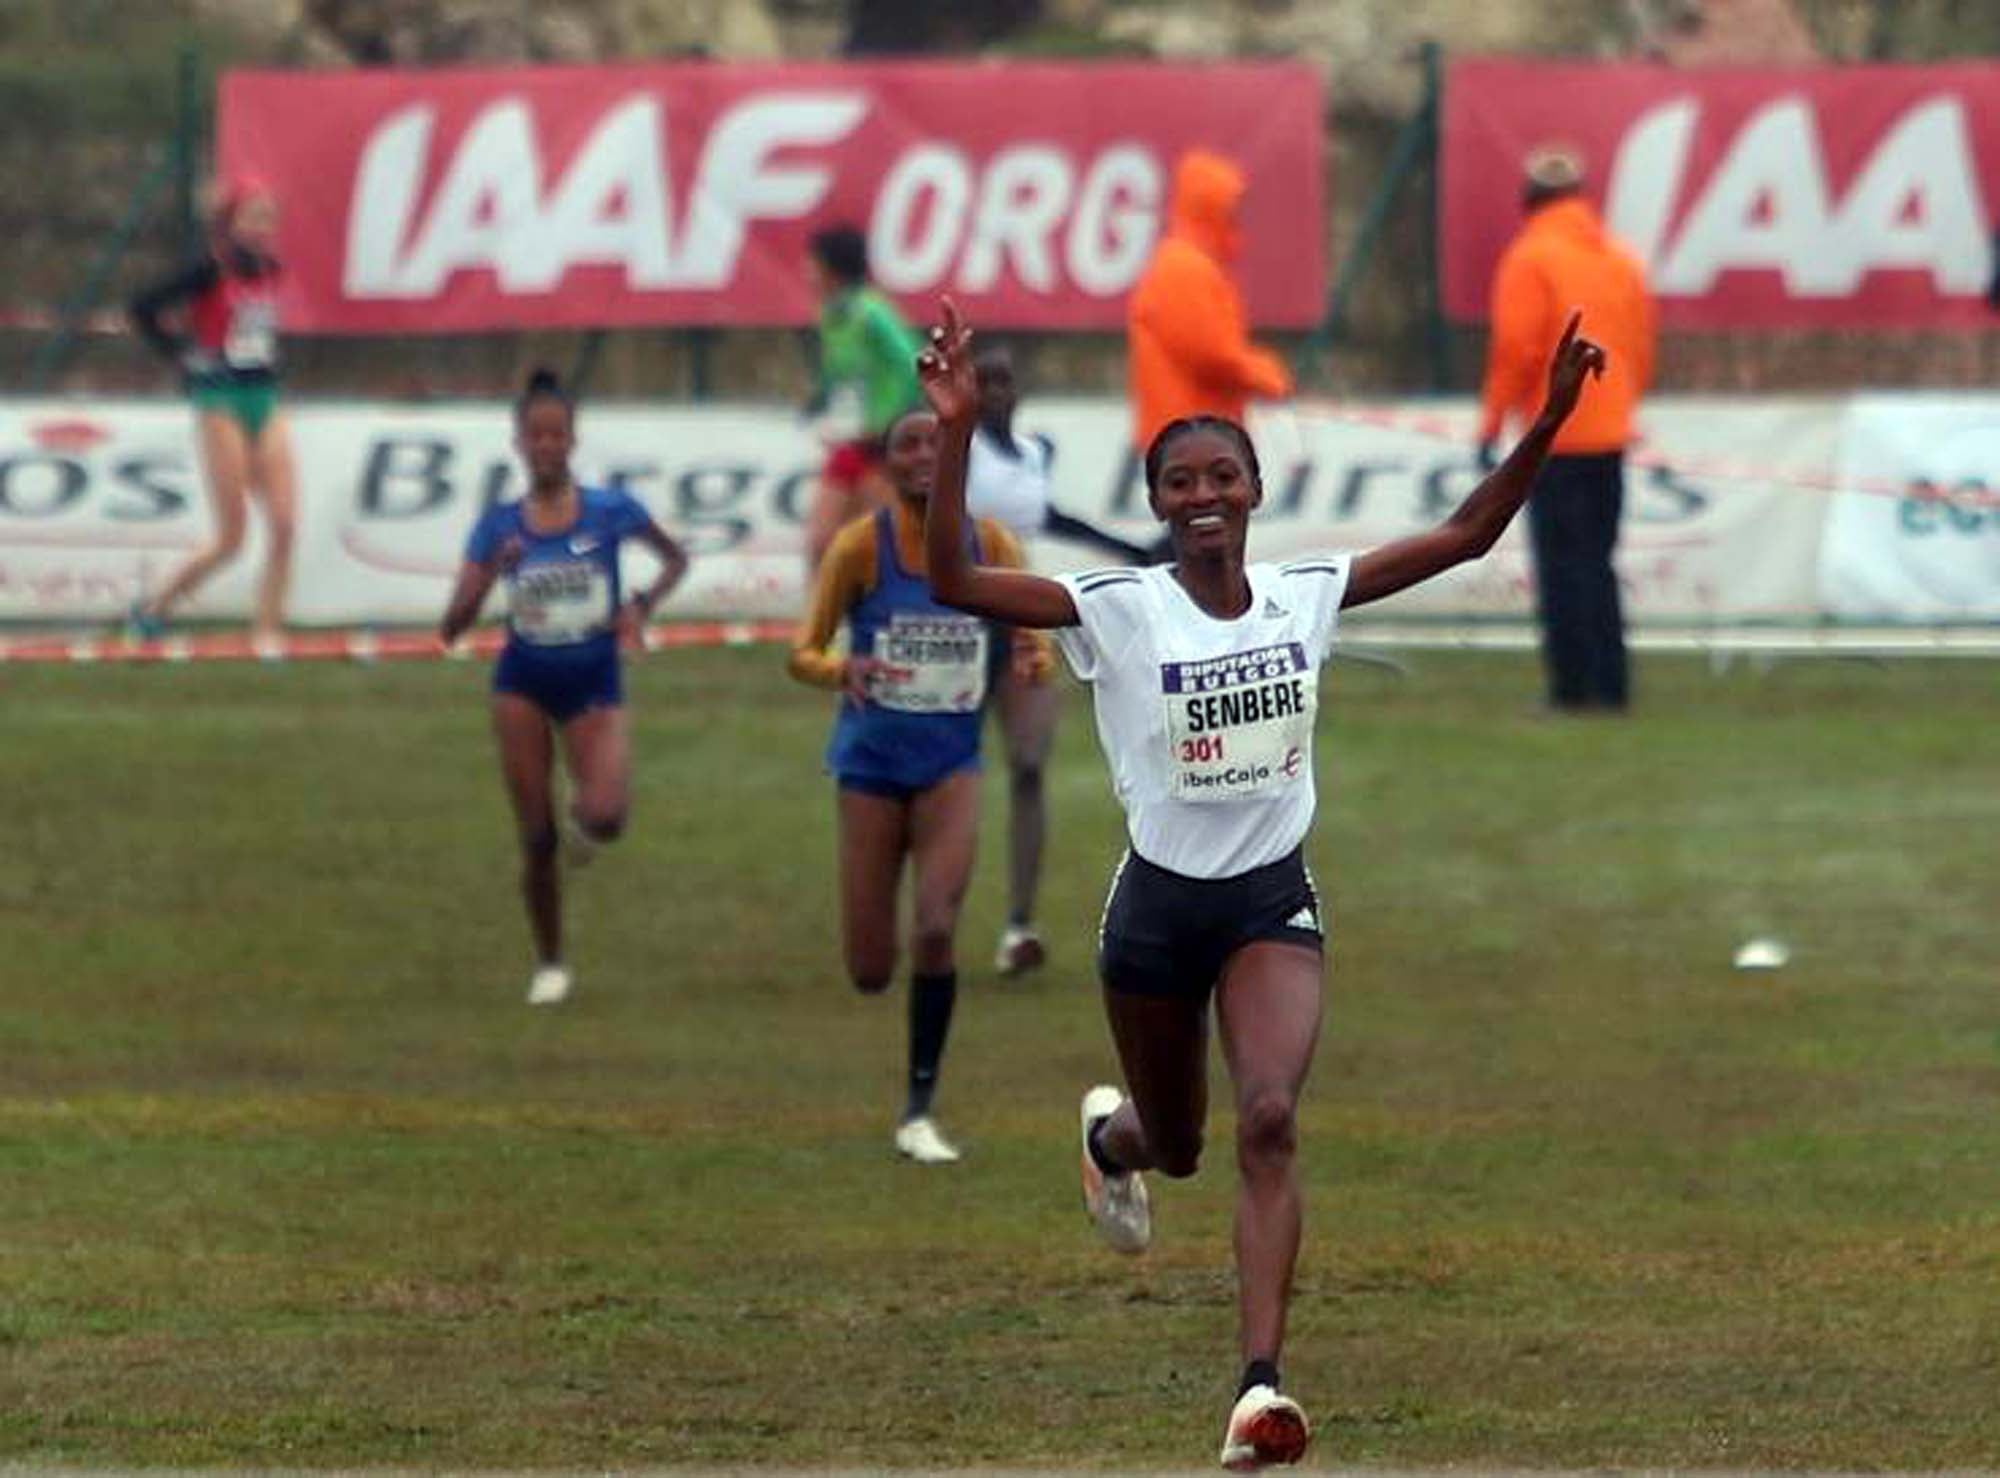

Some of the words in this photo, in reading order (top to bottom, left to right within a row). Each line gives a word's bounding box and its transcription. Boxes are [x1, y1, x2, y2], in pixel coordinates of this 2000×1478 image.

[343, 93, 870, 298] IAAF
[868, 143, 1164, 293] ORG
[1181, 663, 1295, 692] BURGOS
[1186, 679, 1305, 732] SENBERE
[1181, 736, 1222, 762] 301
